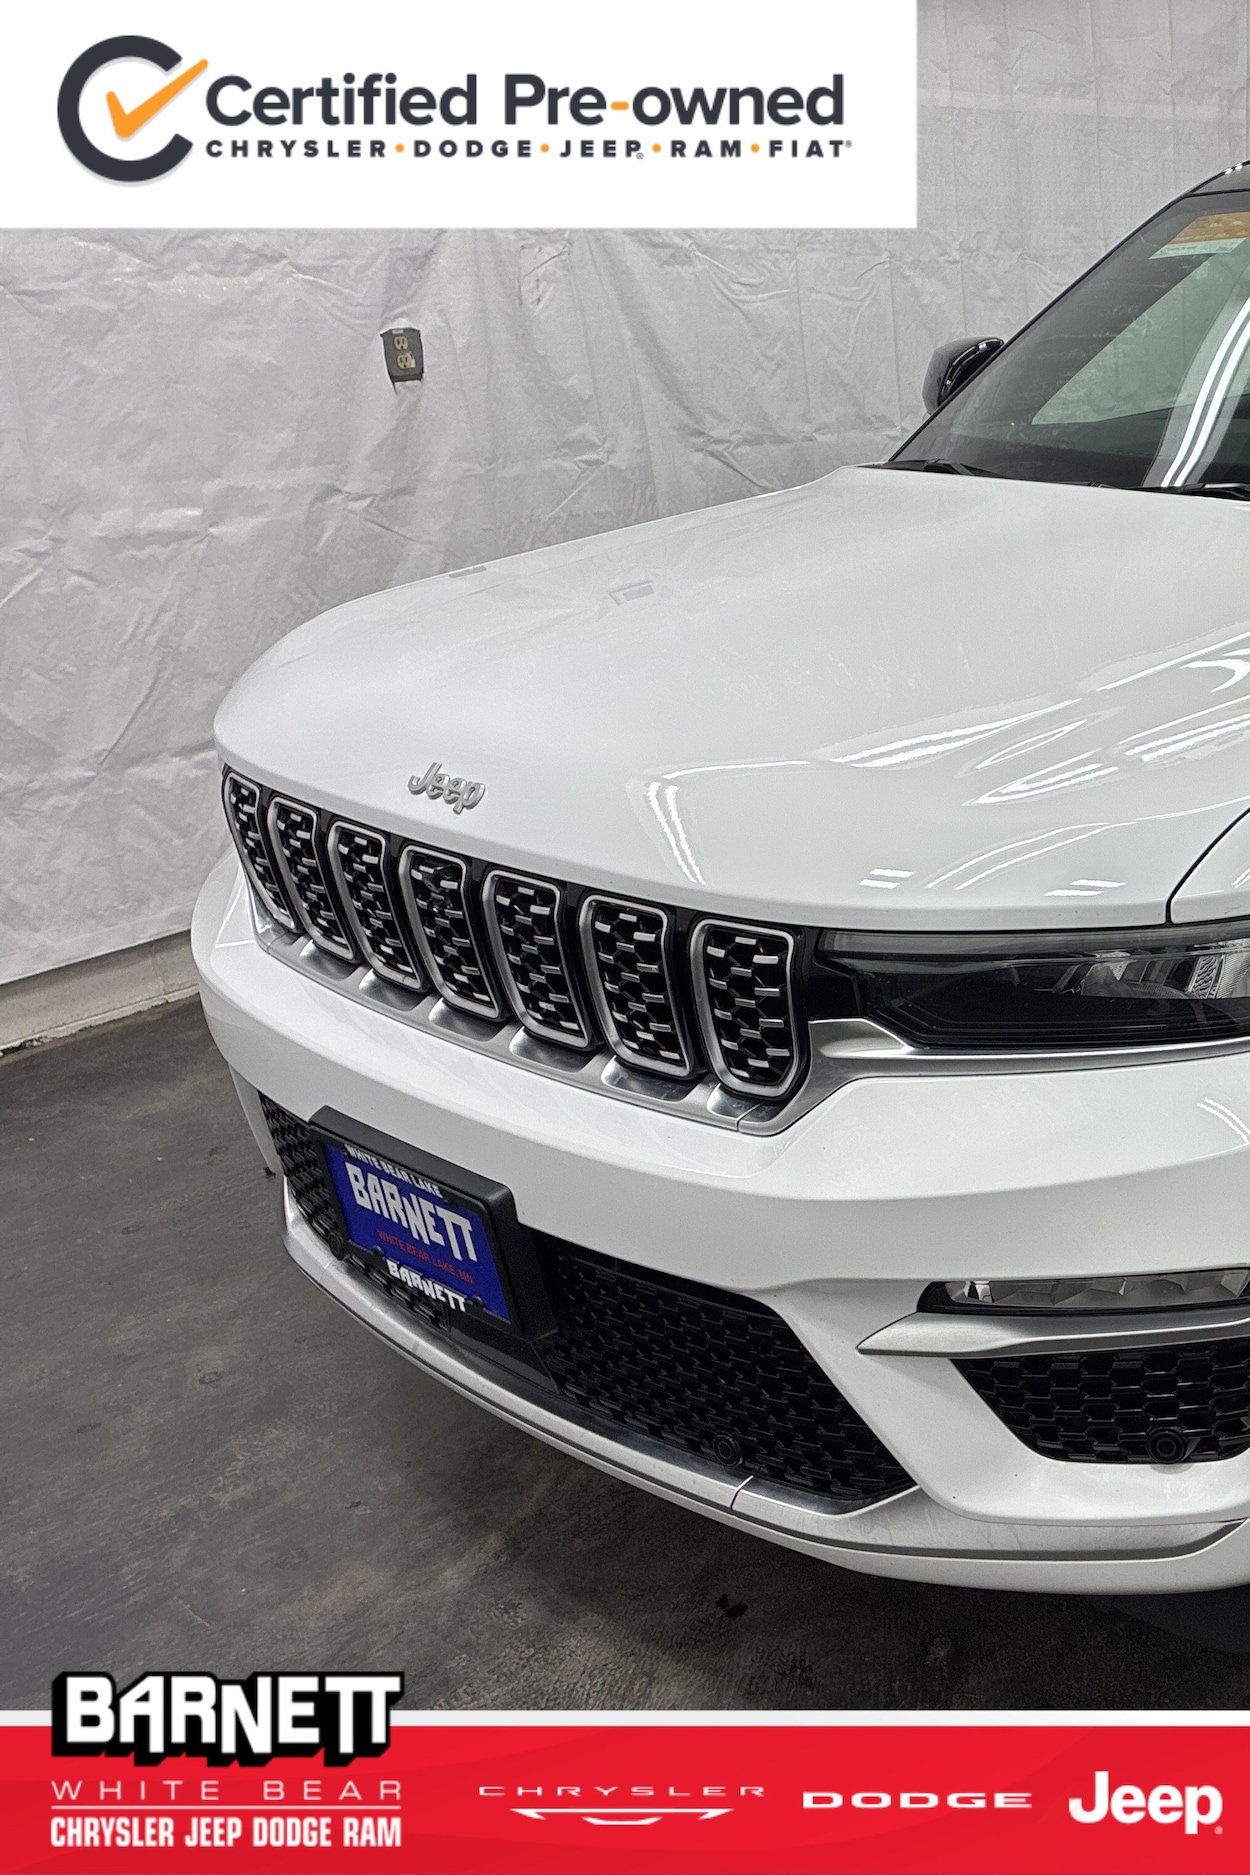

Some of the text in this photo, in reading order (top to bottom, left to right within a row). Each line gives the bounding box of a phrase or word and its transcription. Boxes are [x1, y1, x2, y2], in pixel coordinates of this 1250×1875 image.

[408, 762, 486, 815] Jeep
[344, 1143, 444, 1199] WHITE BEAR LAKE
[345, 1161, 478, 1262] BARNETT
[377, 1229, 406, 1252] WHITE
[406, 1242, 432, 1264] BEAR
[386, 1259, 466, 1313] BARNETT
